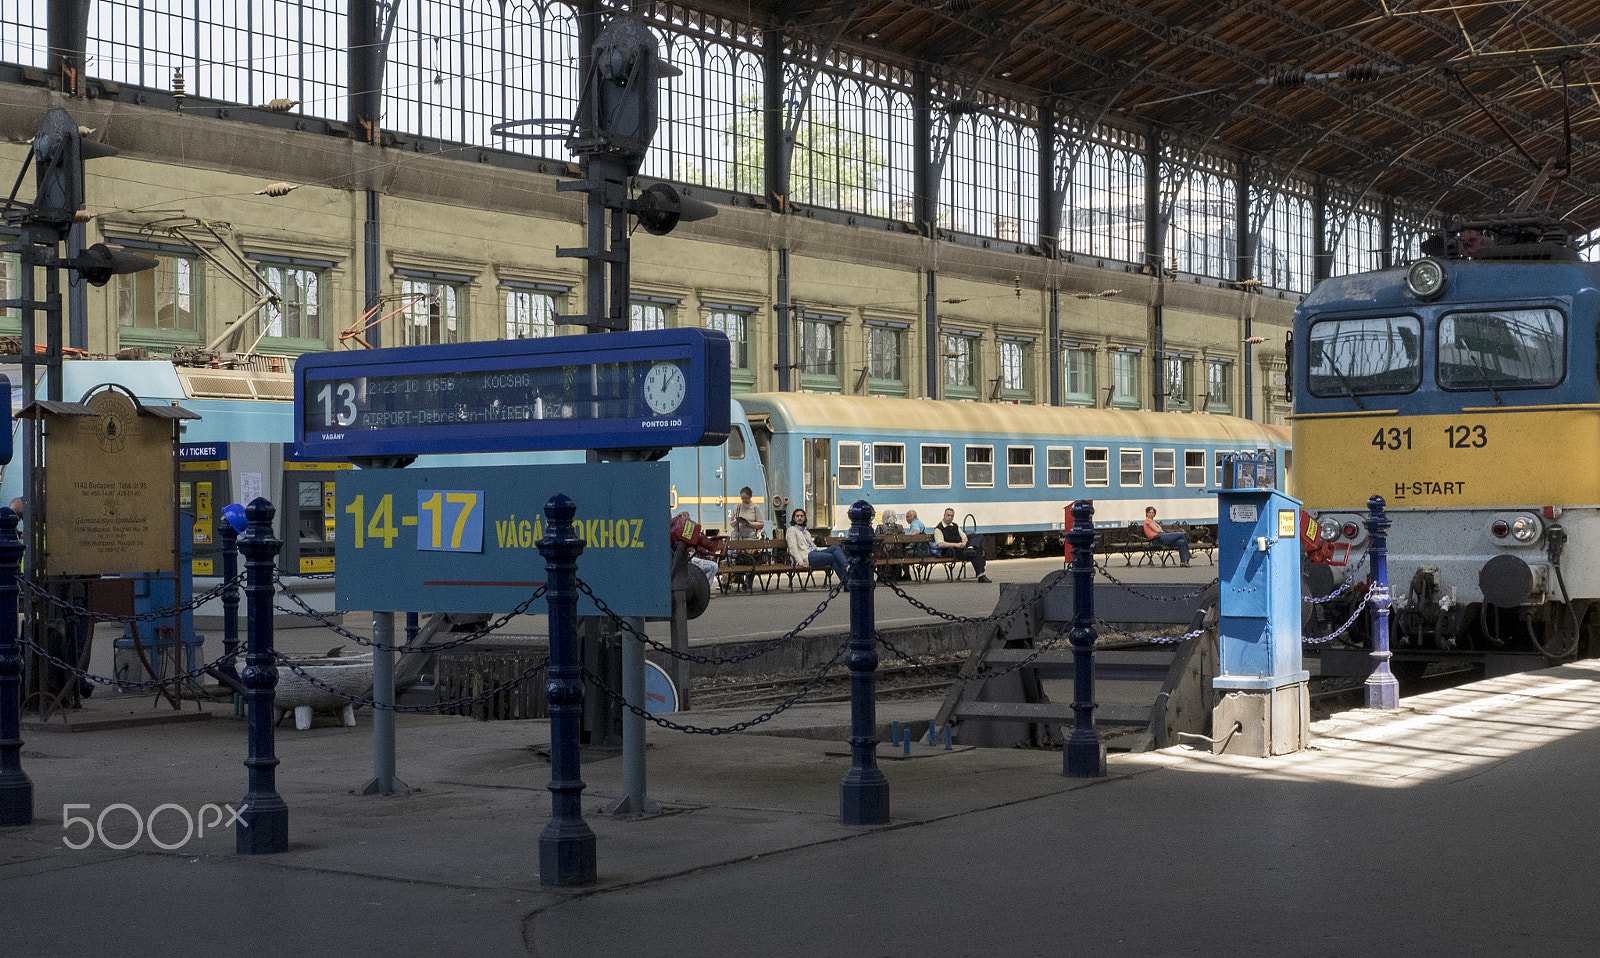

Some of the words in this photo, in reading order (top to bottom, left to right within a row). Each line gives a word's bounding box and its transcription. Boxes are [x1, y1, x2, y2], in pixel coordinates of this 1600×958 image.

[404, 379, 419, 393] IC
[317, 382, 358, 427] 13
[641, 420, 669, 428] PONTOS
[1371, 426, 1412, 451] 431
[1444, 424, 1488, 449] 123
[189, 447, 217, 457] TICKETS
[864, 444, 871, 456] 2
[1394, 481, 1466, 499] H-START
[494, 513, 645, 549] VÁGÁOKHOZ
